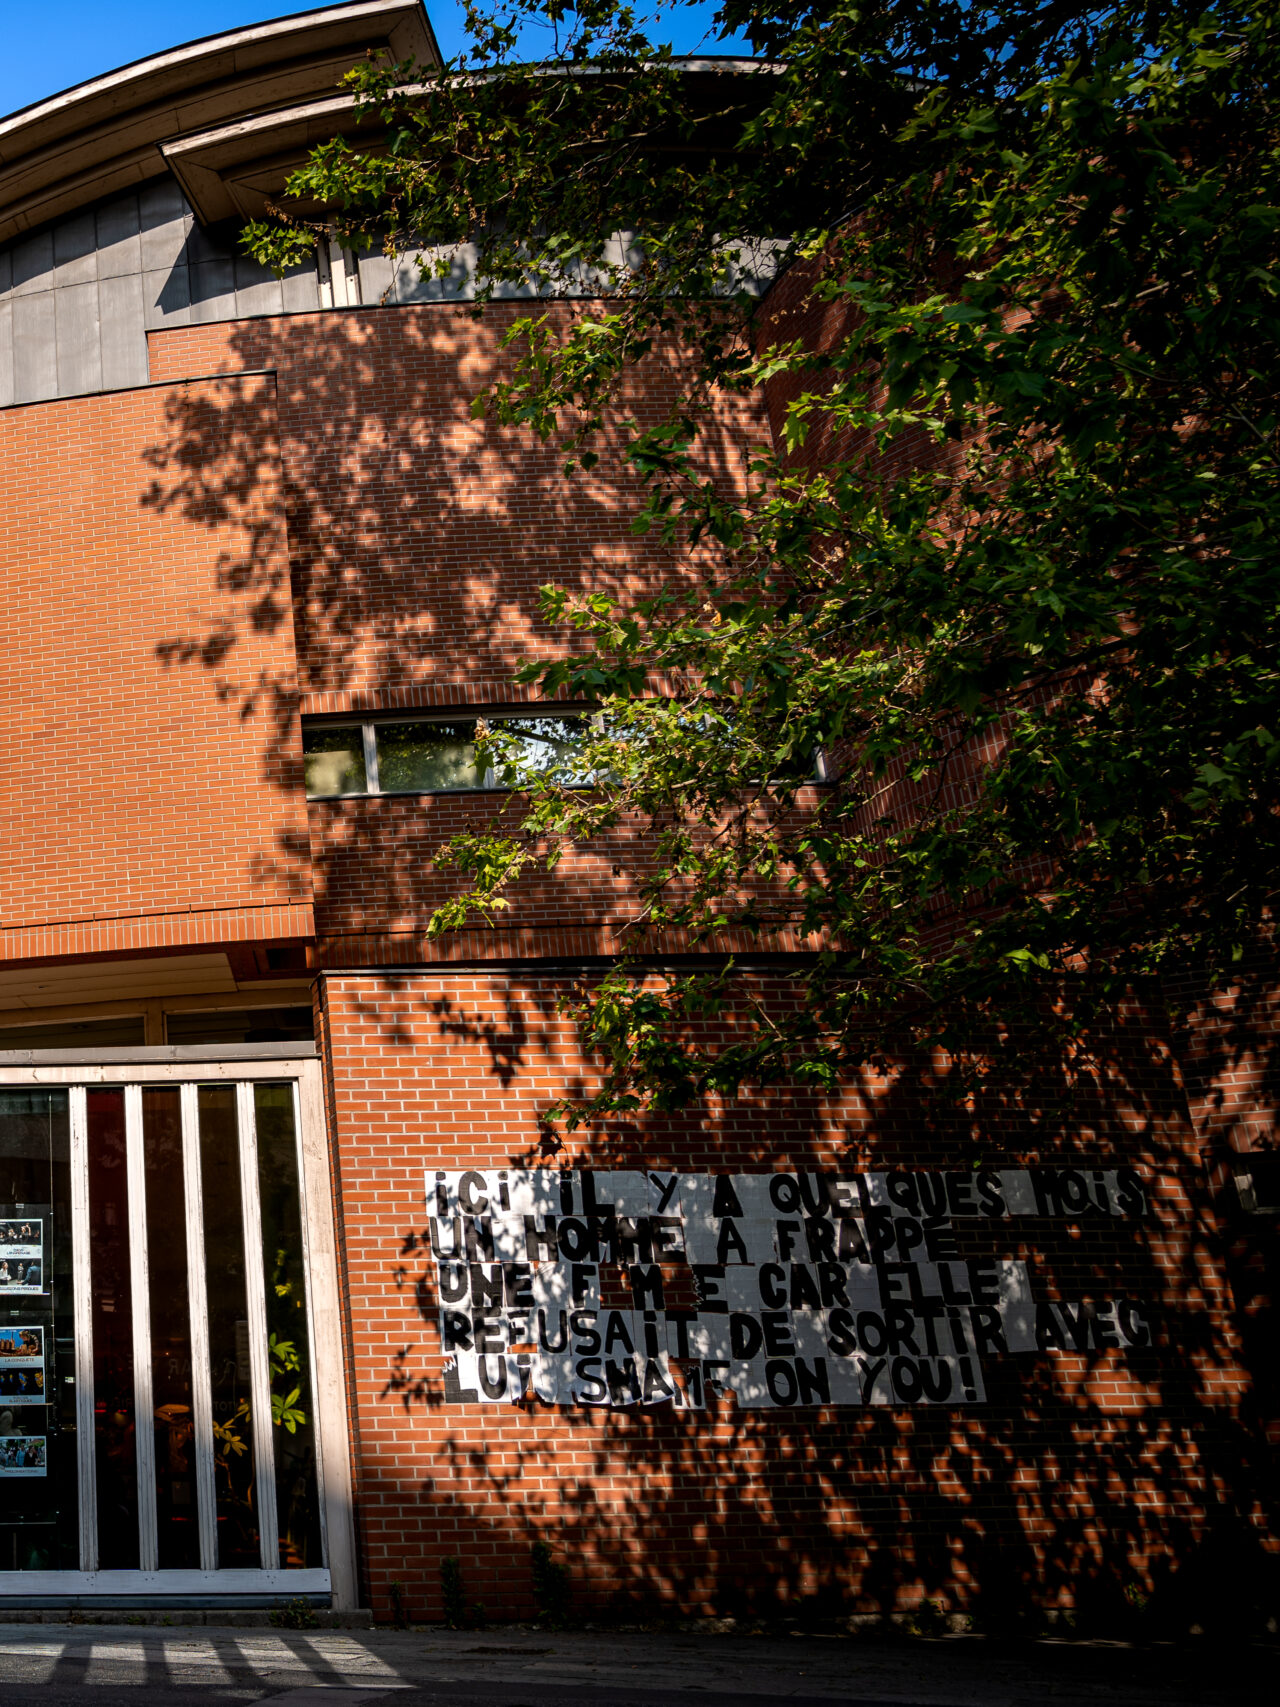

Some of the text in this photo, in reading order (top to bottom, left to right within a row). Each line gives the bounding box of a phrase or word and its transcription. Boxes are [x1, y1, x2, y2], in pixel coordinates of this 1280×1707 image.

[649, 1172, 678, 1213] Y
[713, 1174, 743, 1218] A
[769, 1171, 1006, 1218] QUELQUES
[430, 1217, 493, 1261] UN
[524, 1215, 686, 1264] HOMME
[716, 1217, 748, 1264] A
[439, 1259, 1000, 1313] UNE FME CAR ELLE
[729, 1311, 795, 1359] DE
[1035, 1300, 1151, 1350] AVEC
[766, 1357, 831, 1406] ON
